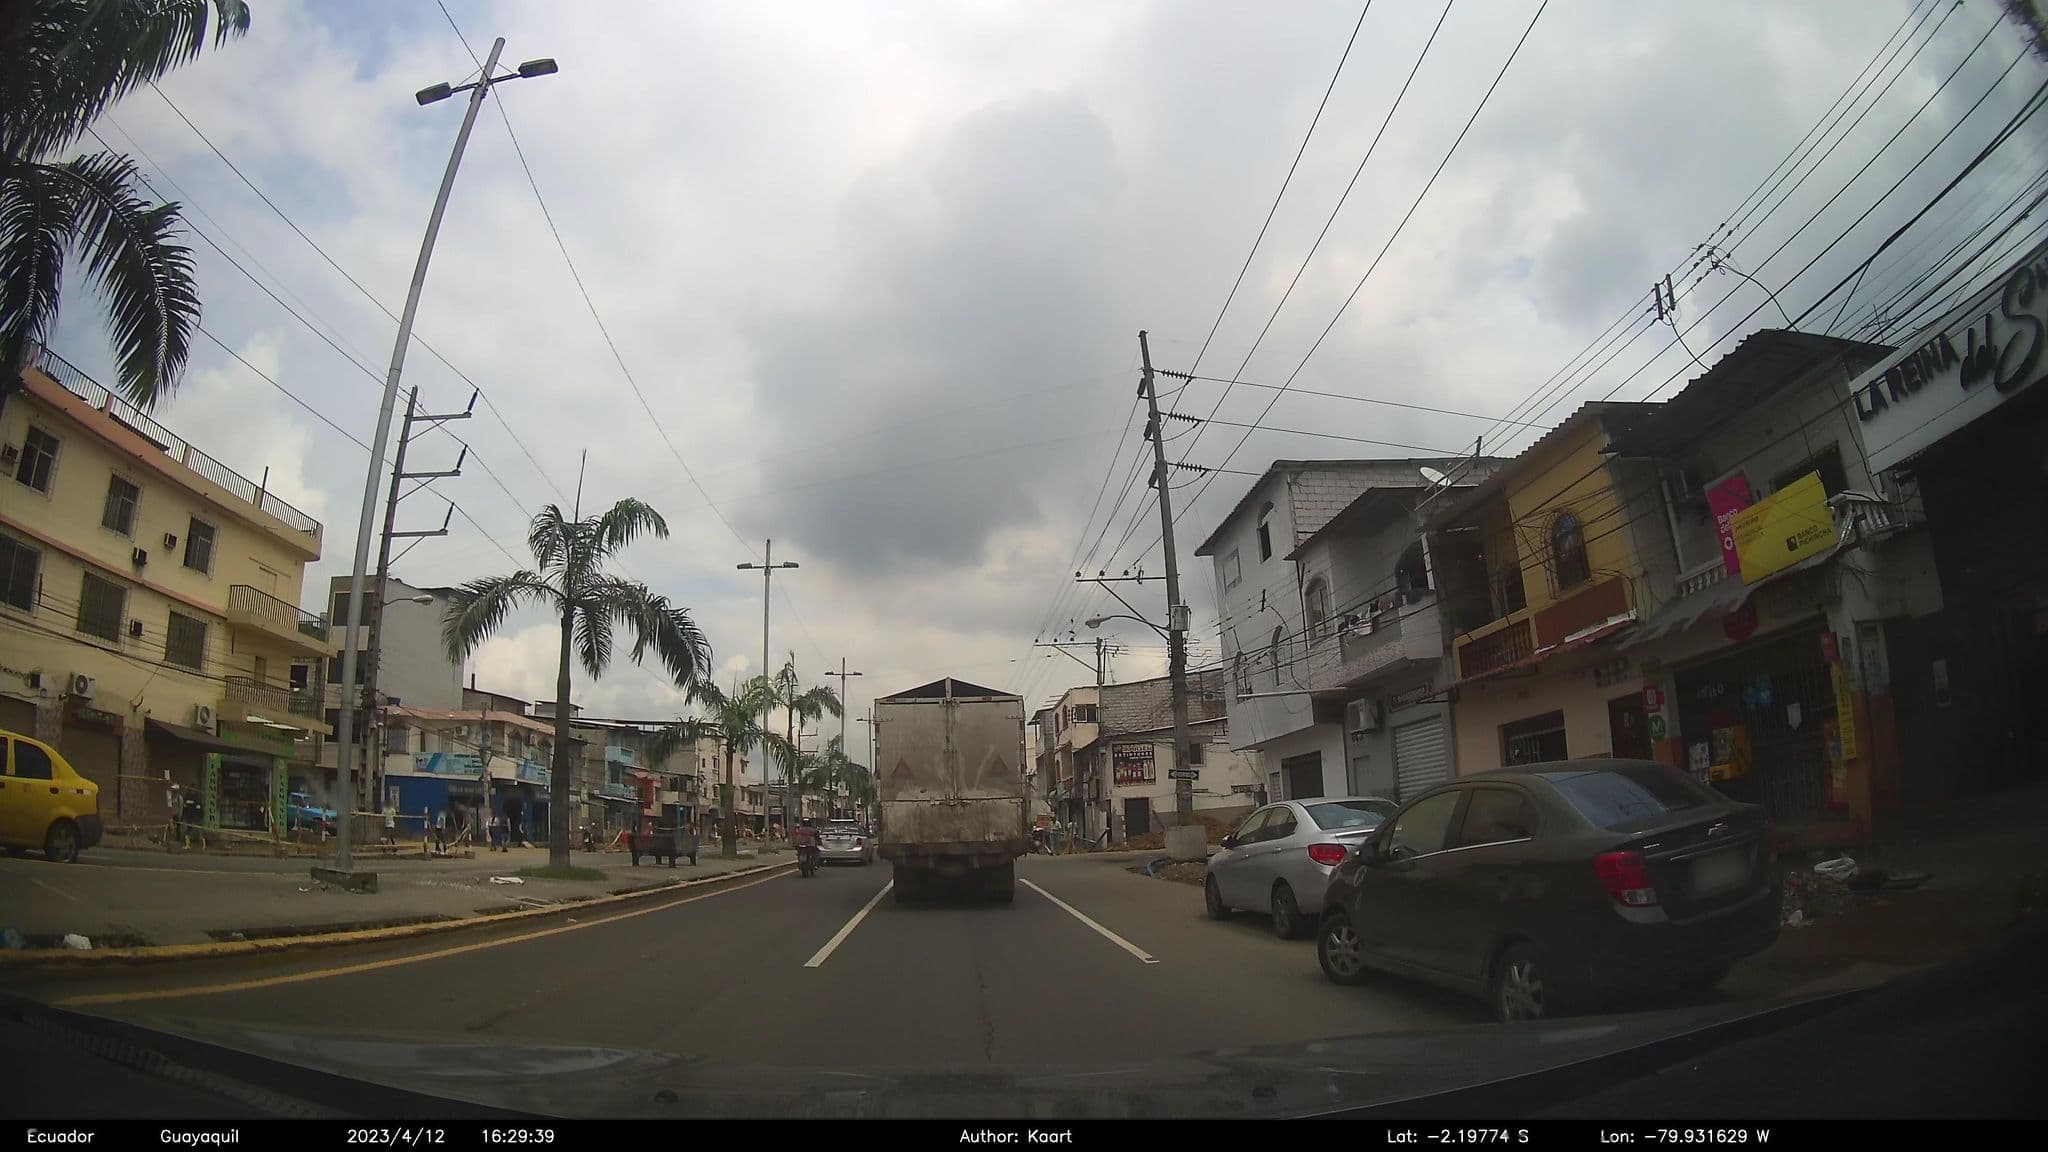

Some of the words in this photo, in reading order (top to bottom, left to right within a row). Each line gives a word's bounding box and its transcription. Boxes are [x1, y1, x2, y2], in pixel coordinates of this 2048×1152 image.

[1853, 380, 1889, 422] LA
[1884, 332, 1960, 403] REINA
[1798, 525, 1819, 539] BANCO
